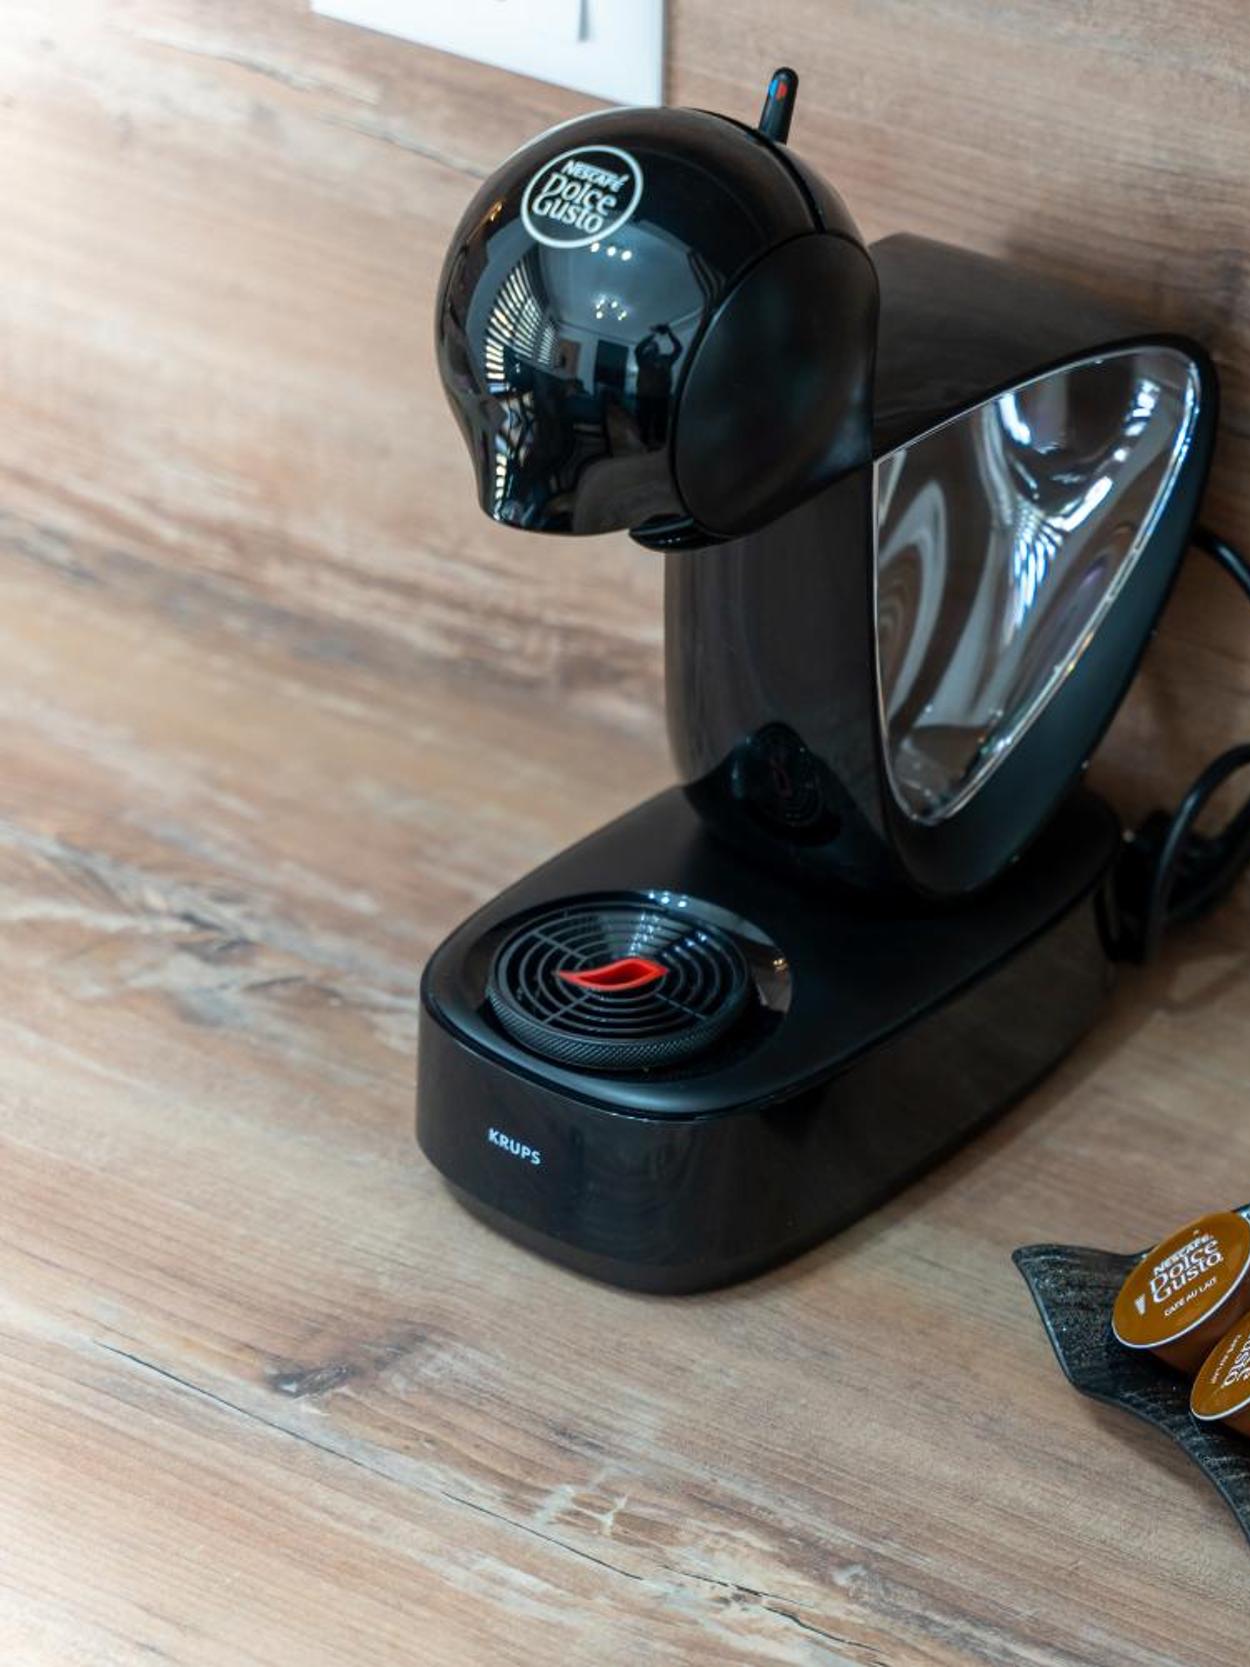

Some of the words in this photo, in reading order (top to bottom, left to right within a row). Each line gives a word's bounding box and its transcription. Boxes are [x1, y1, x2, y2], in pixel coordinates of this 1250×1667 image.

[532, 193, 604, 234] Gusto
[542, 172, 617, 216] Dolce
[488, 1127, 541, 1165] KRUPS
[1153, 1252, 1224, 1303] Gusto
